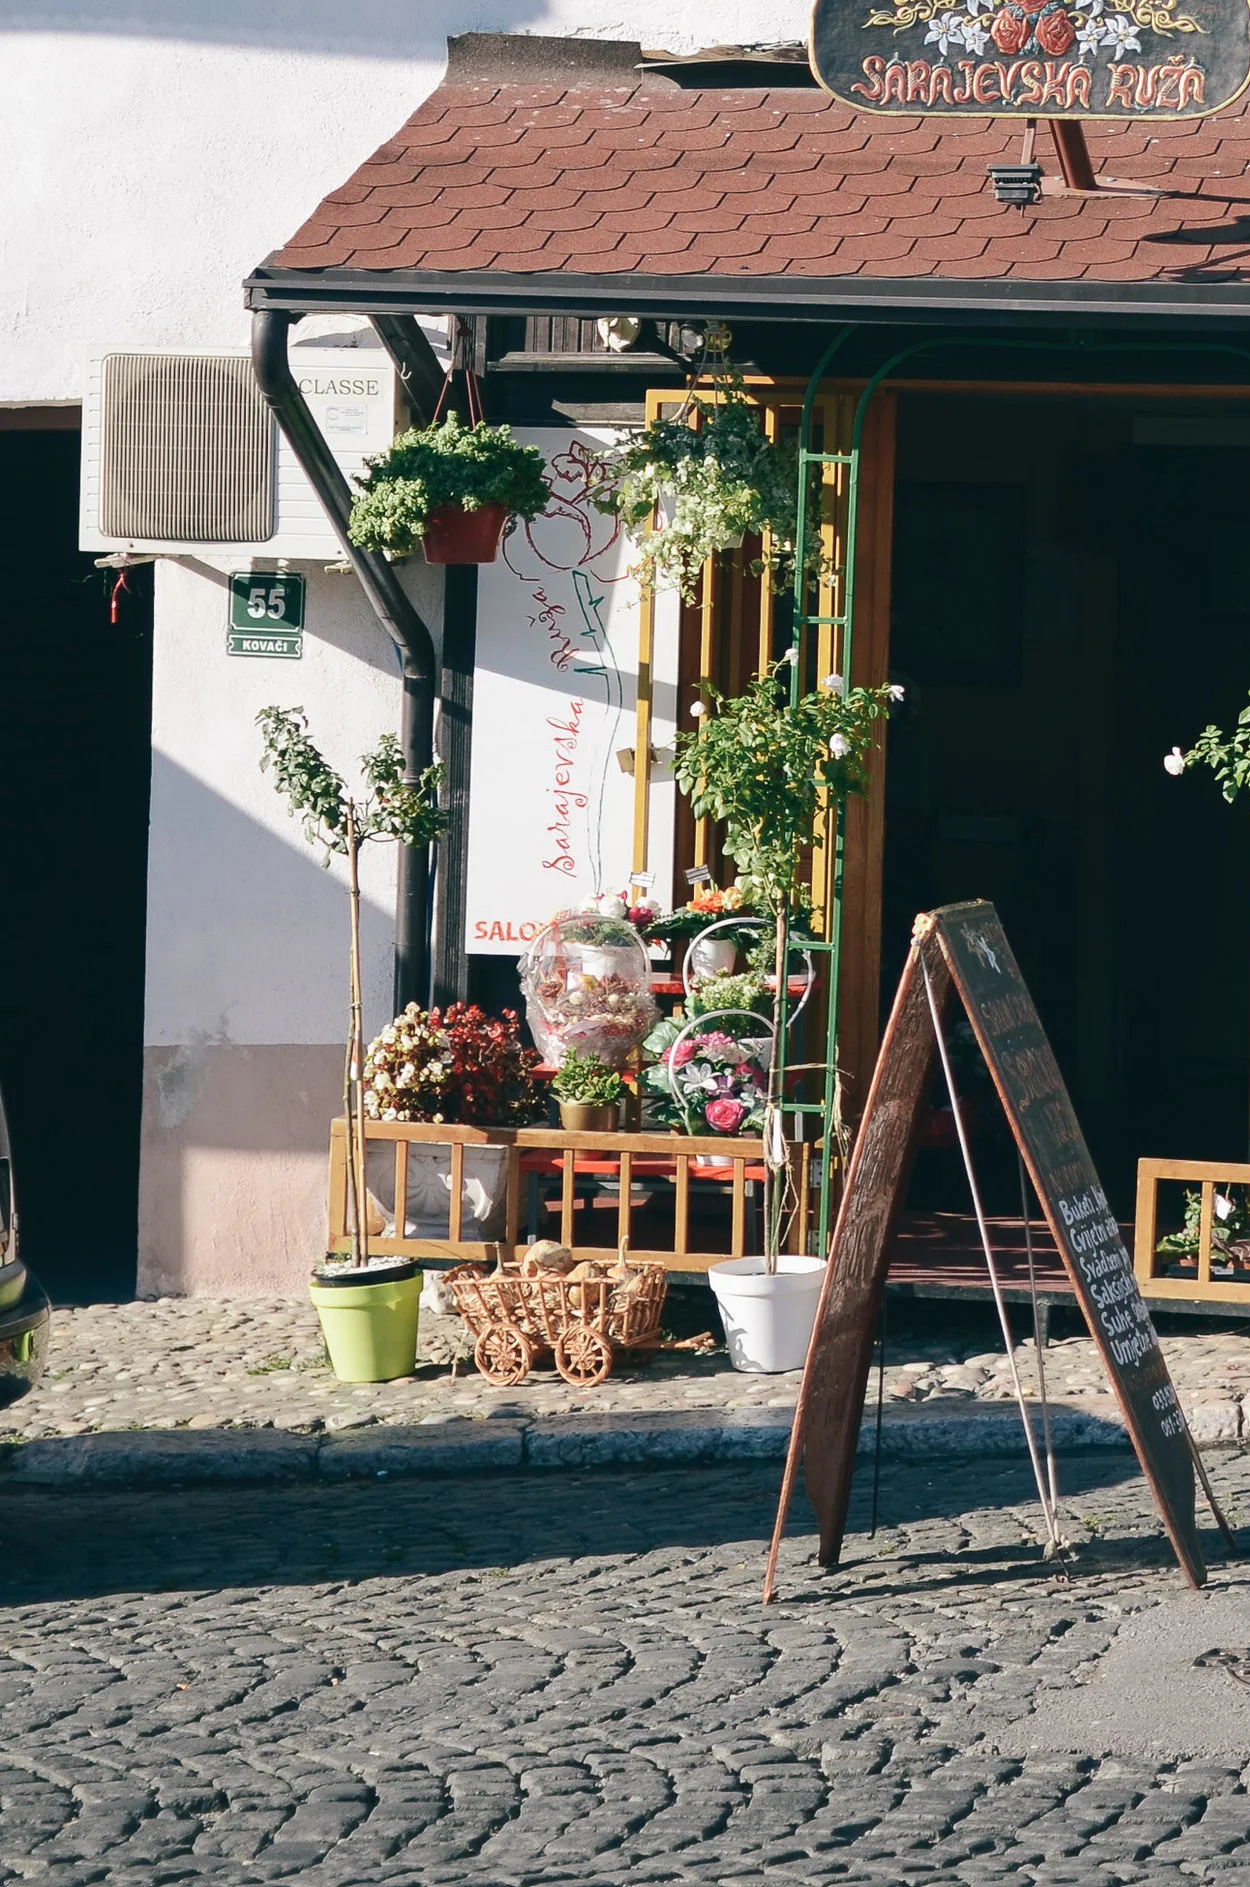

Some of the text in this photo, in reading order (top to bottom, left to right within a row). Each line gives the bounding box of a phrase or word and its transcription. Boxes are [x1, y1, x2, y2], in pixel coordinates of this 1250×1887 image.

[851, 54, 1206, 111] SARAJEVSKA RUŽA
[298, 378, 379, 396] CLASSE
[246, 587, 286, 620] 55
[242, 639, 289, 653] KOVAČI
